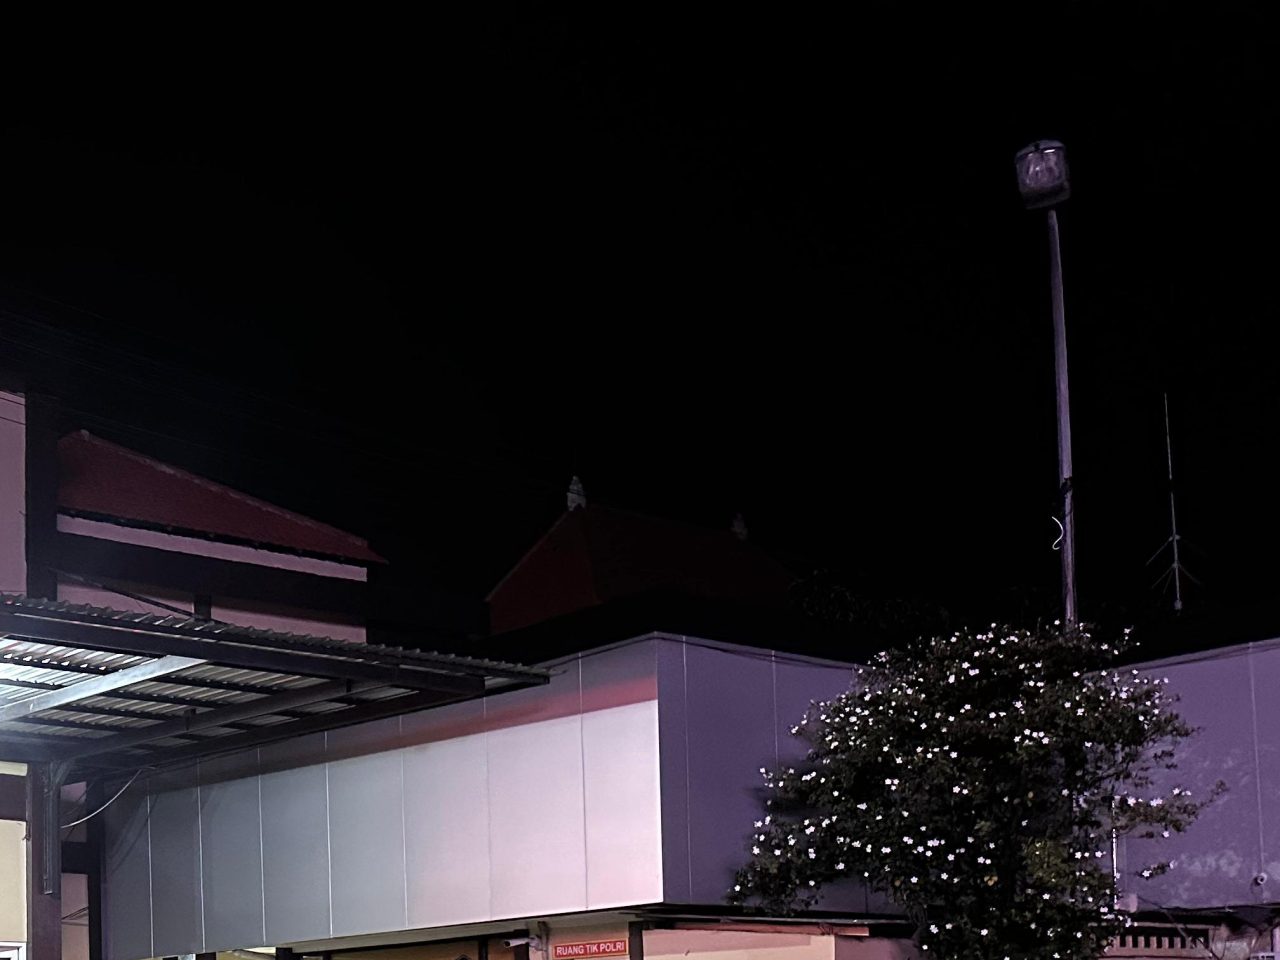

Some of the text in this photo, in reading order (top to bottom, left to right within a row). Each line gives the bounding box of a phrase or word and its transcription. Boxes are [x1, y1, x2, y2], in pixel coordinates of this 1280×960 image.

[556, 941, 625, 956] RUANG TIK POLRI
